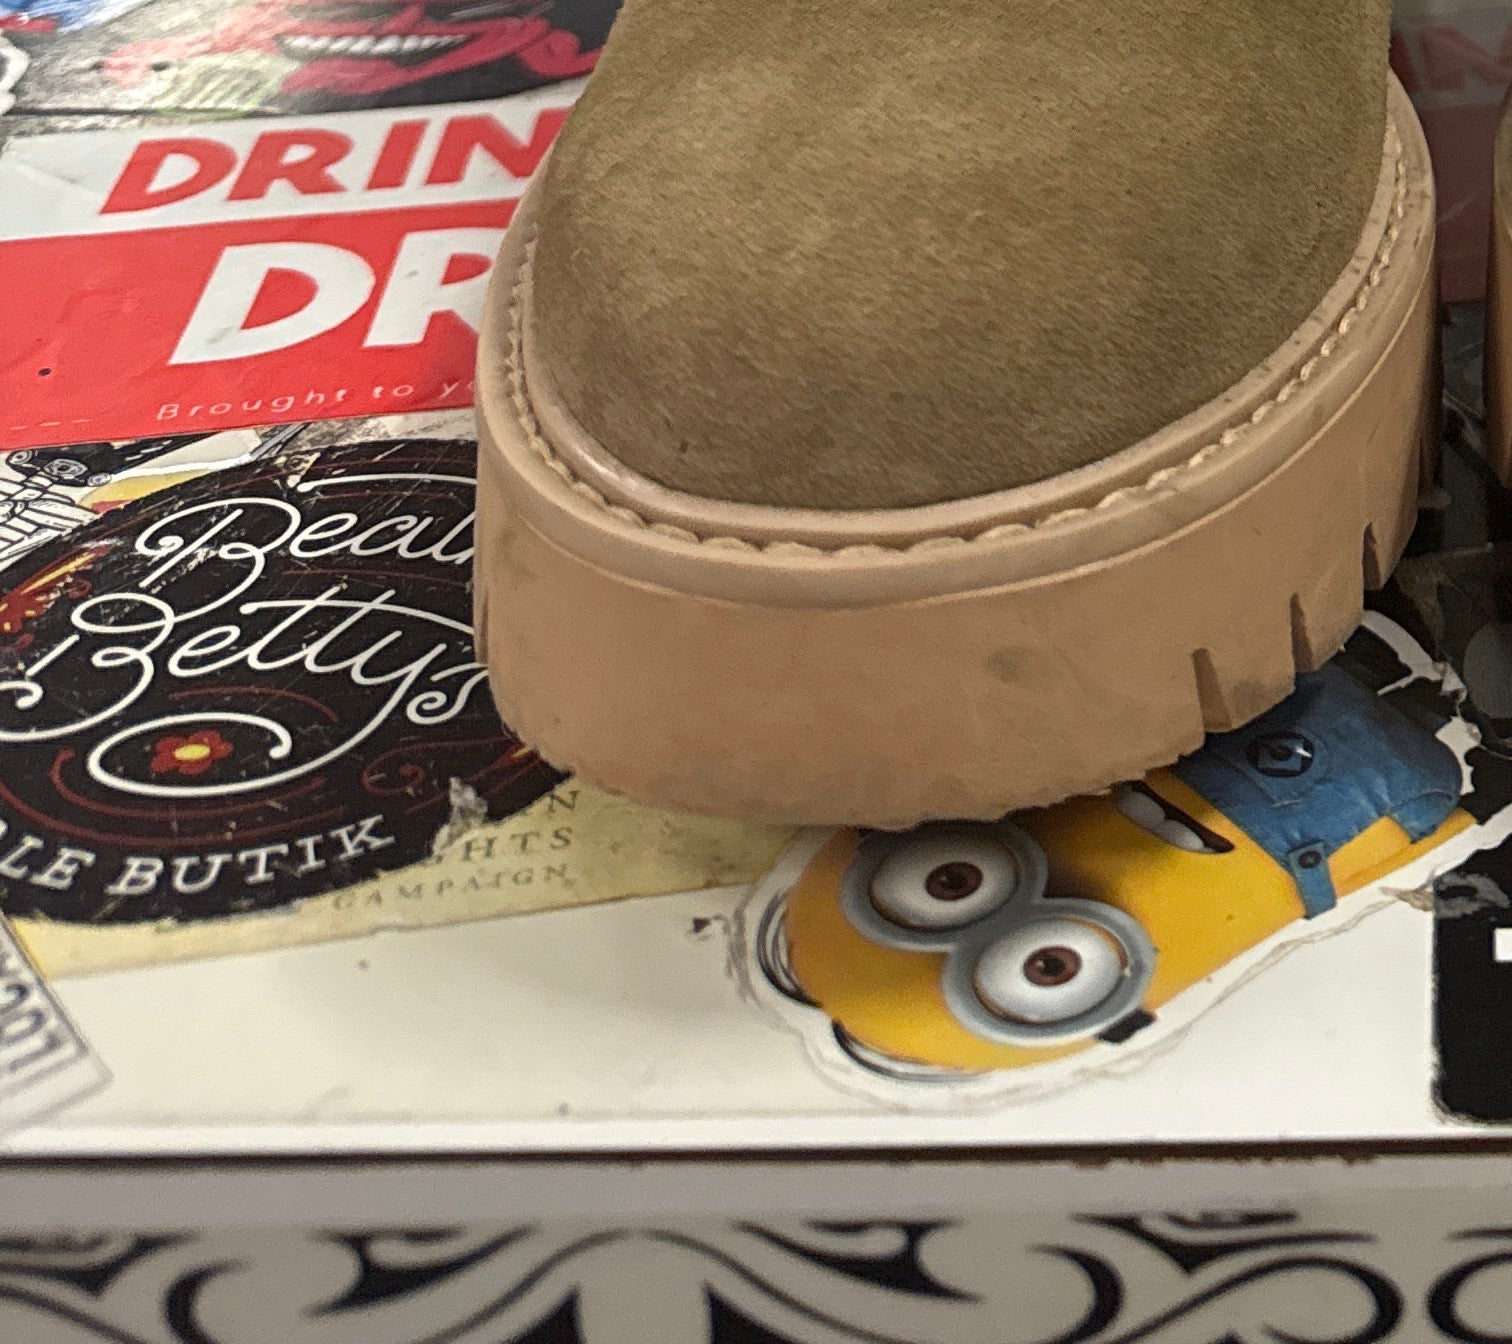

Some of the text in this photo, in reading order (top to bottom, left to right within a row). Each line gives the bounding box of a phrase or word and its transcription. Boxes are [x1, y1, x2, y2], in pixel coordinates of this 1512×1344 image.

[157, 388, 347, 421] Brought
[373, 383, 415, 399] to
[104, 813, 395, 897] BUTIK
[458, 826, 574, 862] HTS
[331, 863, 572, 911] CAMPAIGN
